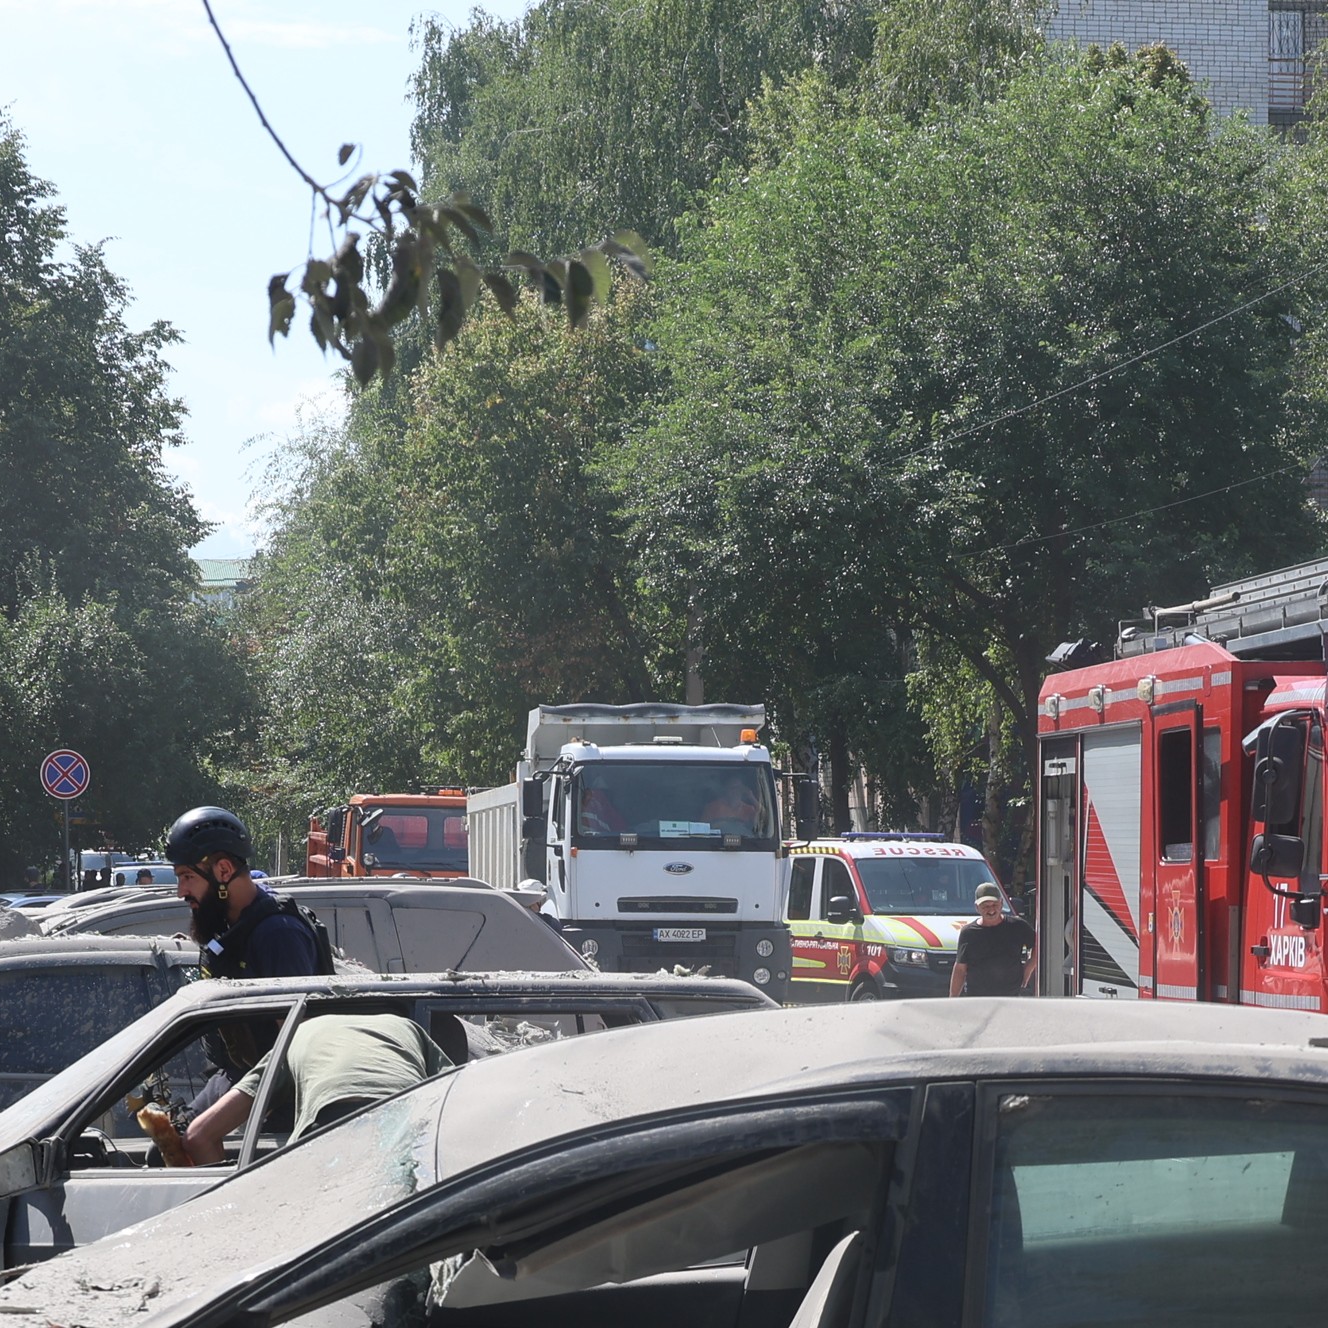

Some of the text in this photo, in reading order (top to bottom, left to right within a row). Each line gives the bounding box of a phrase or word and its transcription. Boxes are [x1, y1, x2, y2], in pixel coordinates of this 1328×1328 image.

[659, 930, 670, 938] AX
[692, 930, 703, 938] EP
[867, 944, 882, 957] 101
[1270, 935, 1305, 968] ХАРКІВ
